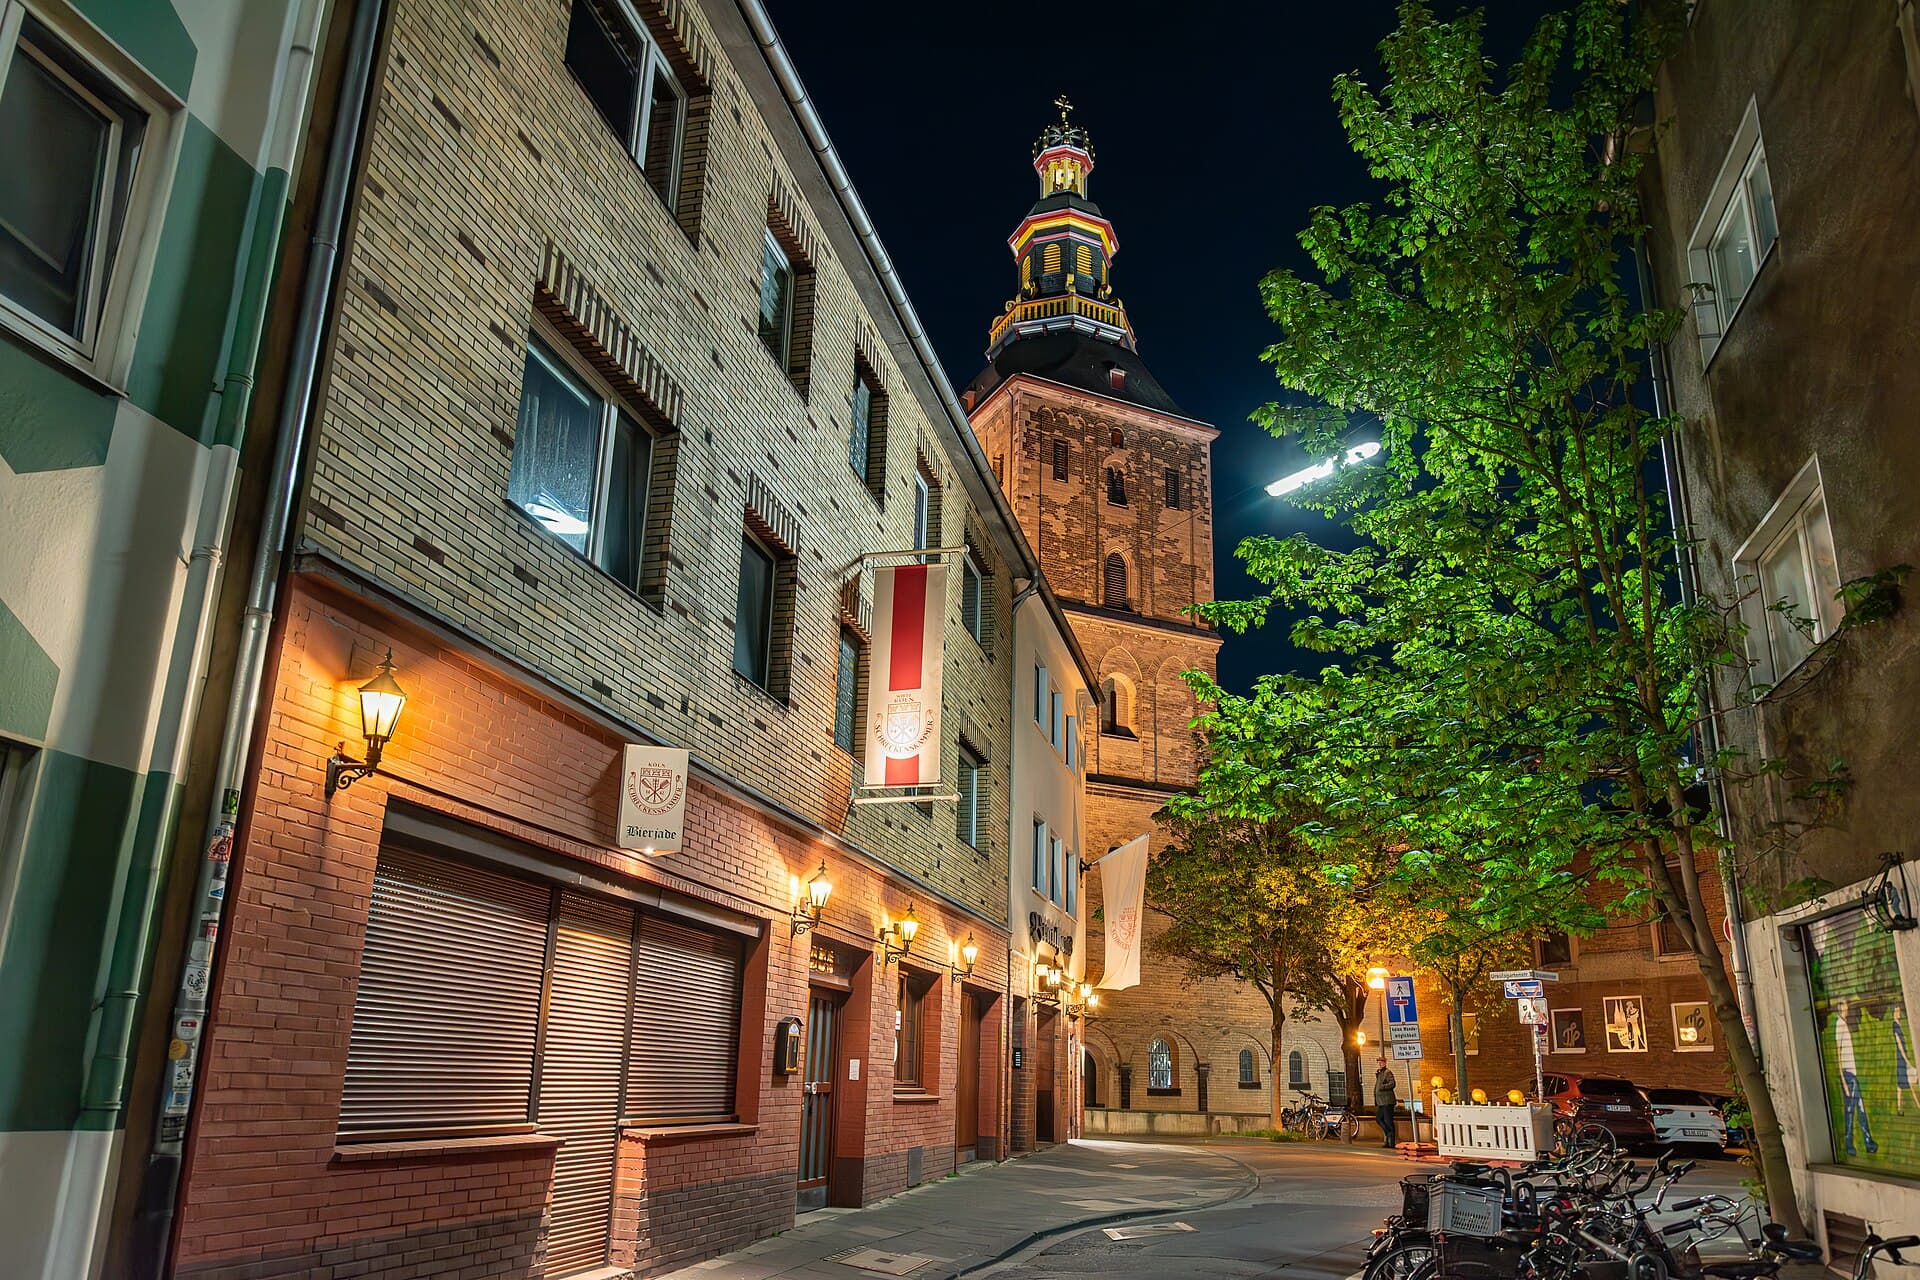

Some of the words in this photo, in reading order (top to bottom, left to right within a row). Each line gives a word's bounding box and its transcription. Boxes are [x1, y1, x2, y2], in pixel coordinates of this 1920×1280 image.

[874, 720, 934, 753] SCHRECKENSKAMMER
[629, 783, 683, 814] SCHRECKENSKAMMER
[626, 825, 677, 840] Bierjade
